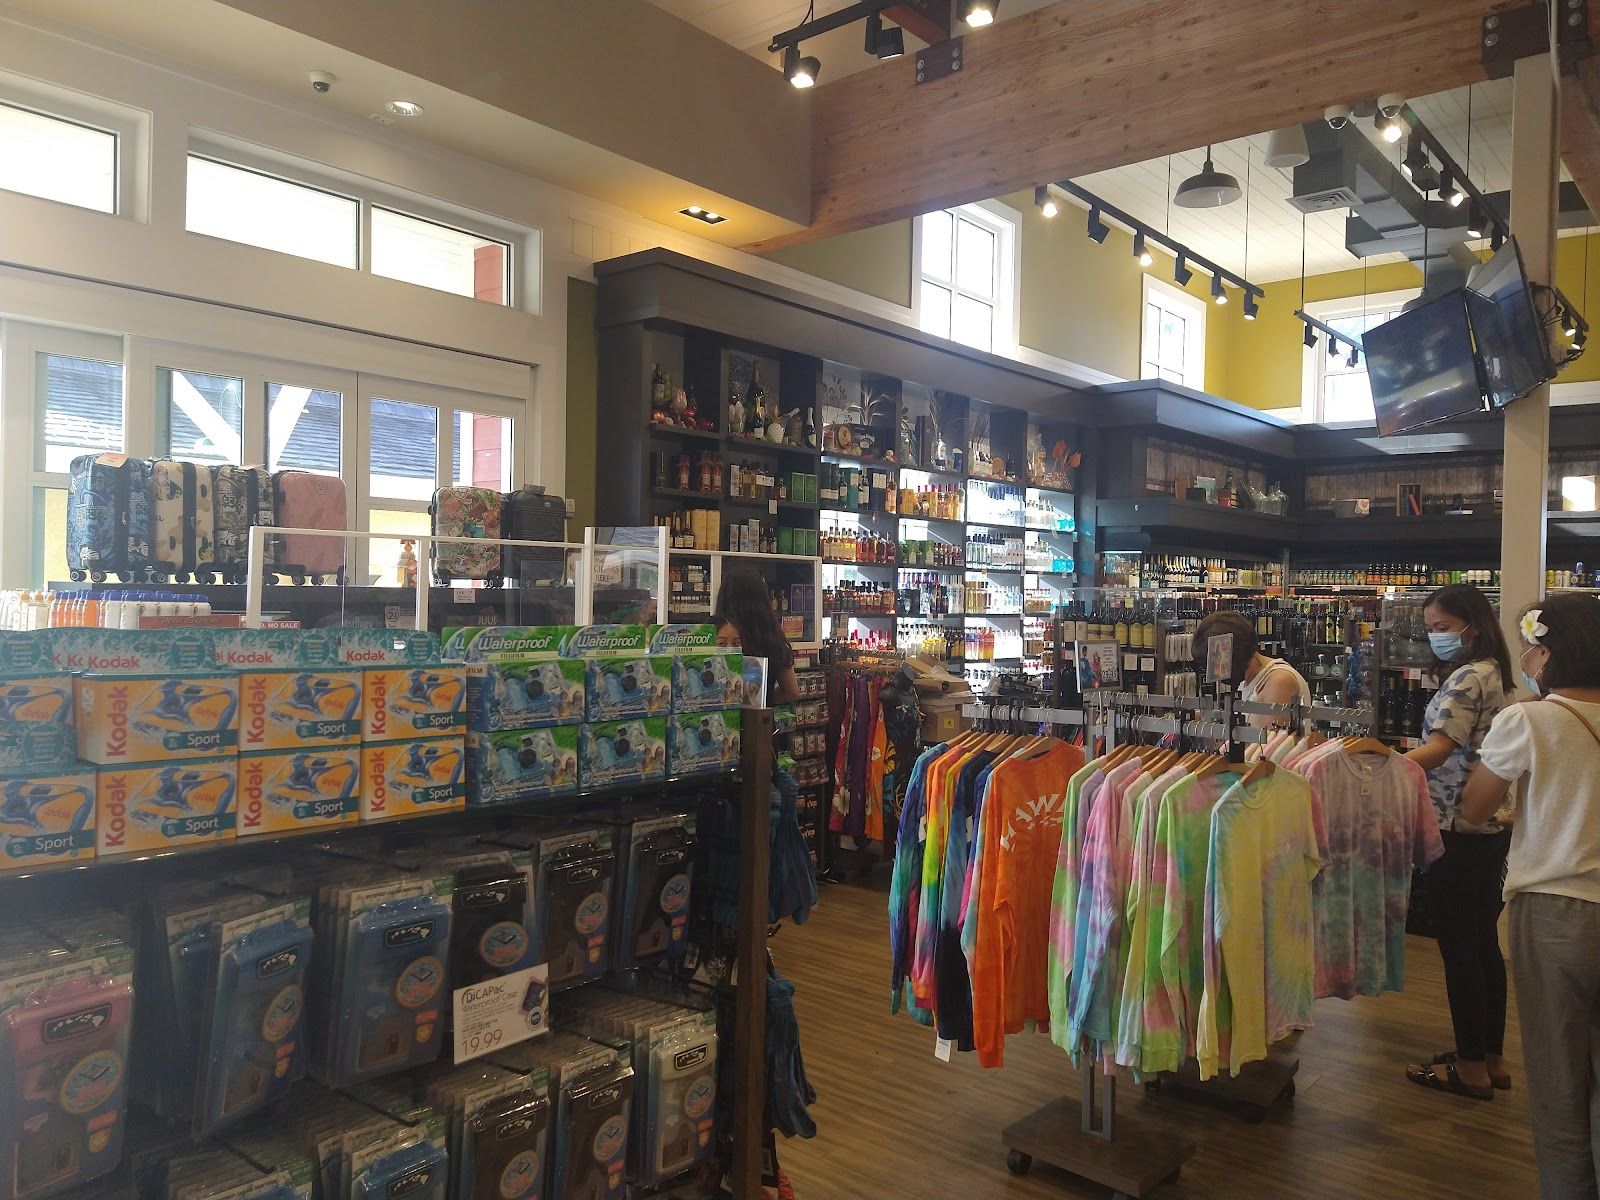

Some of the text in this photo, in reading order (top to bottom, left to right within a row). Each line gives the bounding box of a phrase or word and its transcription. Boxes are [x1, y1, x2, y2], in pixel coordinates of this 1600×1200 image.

[478, 636, 553, 651] Waterproof
[577, 634, 641, 649] Waterproof
[658, 632, 713, 647] Waterproof
[88, 656, 140, 668] Kodak
[228, 651, 273, 664] Kodak
[346, 649, 385, 662] Kodak
[246, 677, 267, 743] Kodak
[371, 674, 386, 735] Kodak
[106, 685, 129, 757] Kodak
[430, 714, 454, 727] Sport
[317, 722, 346, 735] Sport
[187, 733, 221, 748] Sport
[369, 751, 386, 812] Kodak
[243, 760, 263, 828] Kodak
[428, 787, 453, 798] Sport
[105, 774, 127, 847] Kodak
[314, 801, 344, 815] Sport
[186, 817, 219, 832] Sport
[35, 834, 75, 852] Sport
[461, 1029, 503, 1055] 19.99
